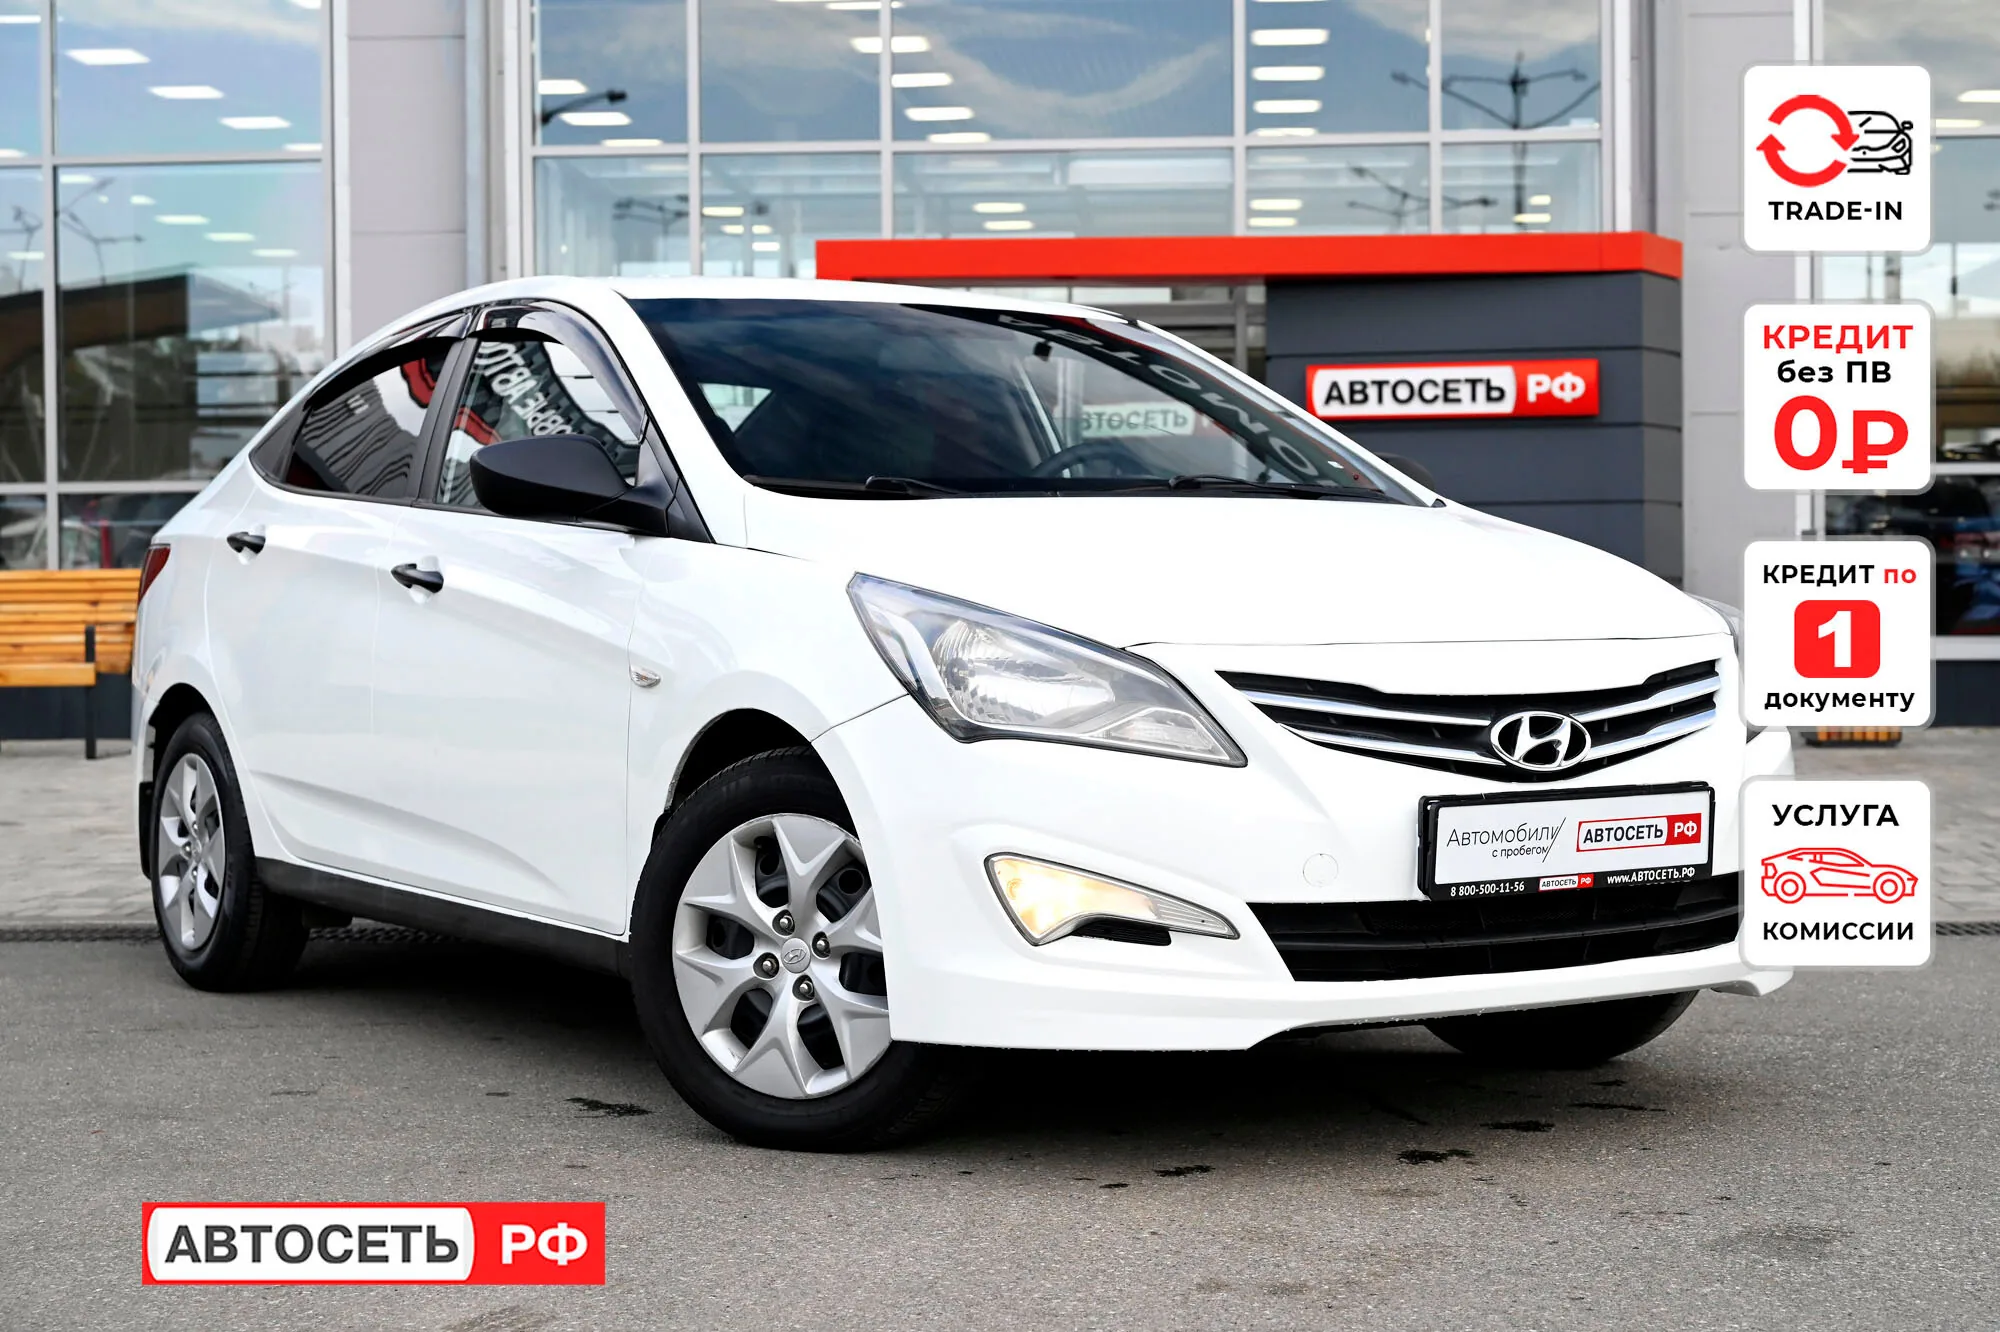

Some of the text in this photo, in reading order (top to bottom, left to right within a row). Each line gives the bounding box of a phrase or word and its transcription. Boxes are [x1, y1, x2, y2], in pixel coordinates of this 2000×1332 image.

[1324, 371, 1586, 406] АВТОСЕТЬ РФ
[1078, 408, 1189, 431] ВТОСЕТЬ
[1583, 820, 1698, 844] АВТОСЕТЬ РФ
[1492, 845, 1549, 859] с пробегом
[1541, 876, 1592, 888] АВТОСЕТЬ РФ
[1607, 866, 1696, 885] www.АВТОСЕТЬ.РФ
[1450, 881, 1525, 897] 8 800-500-11-56
